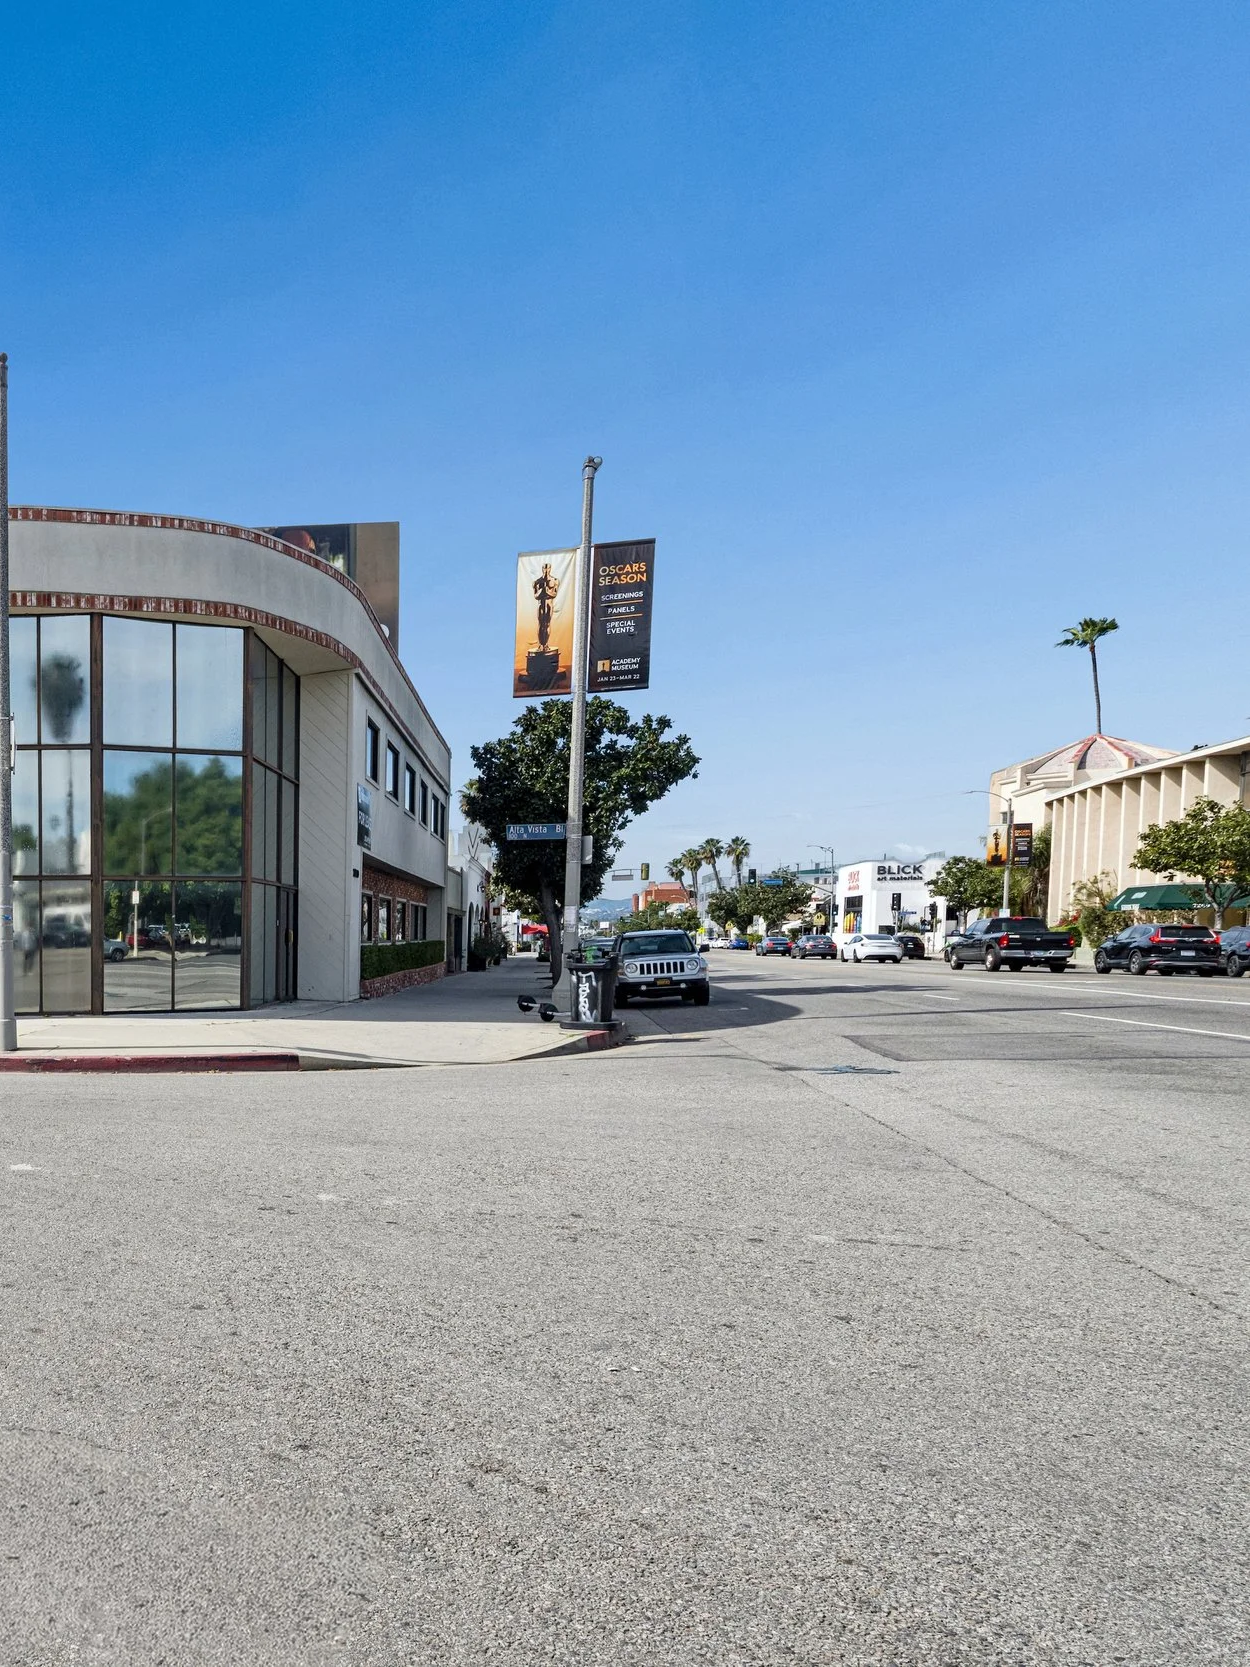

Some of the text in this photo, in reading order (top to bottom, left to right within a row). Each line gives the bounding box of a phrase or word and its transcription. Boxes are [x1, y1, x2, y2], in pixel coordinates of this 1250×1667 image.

[599, 562, 647, 576] OSCARS
[598, 573, 647, 586] SEASON
[601, 591, 644, 601] SCREENINGS
[607, 605, 635, 614] PANELS
[606, 620, 636, 628] SPECIAL
[606, 626, 635, 635] EVENTS
[611, 657, 641, 665] ACADEMY
[509, 824, 564, 834] Alta Vista Bl
[877, 865, 923, 875] BLICK
